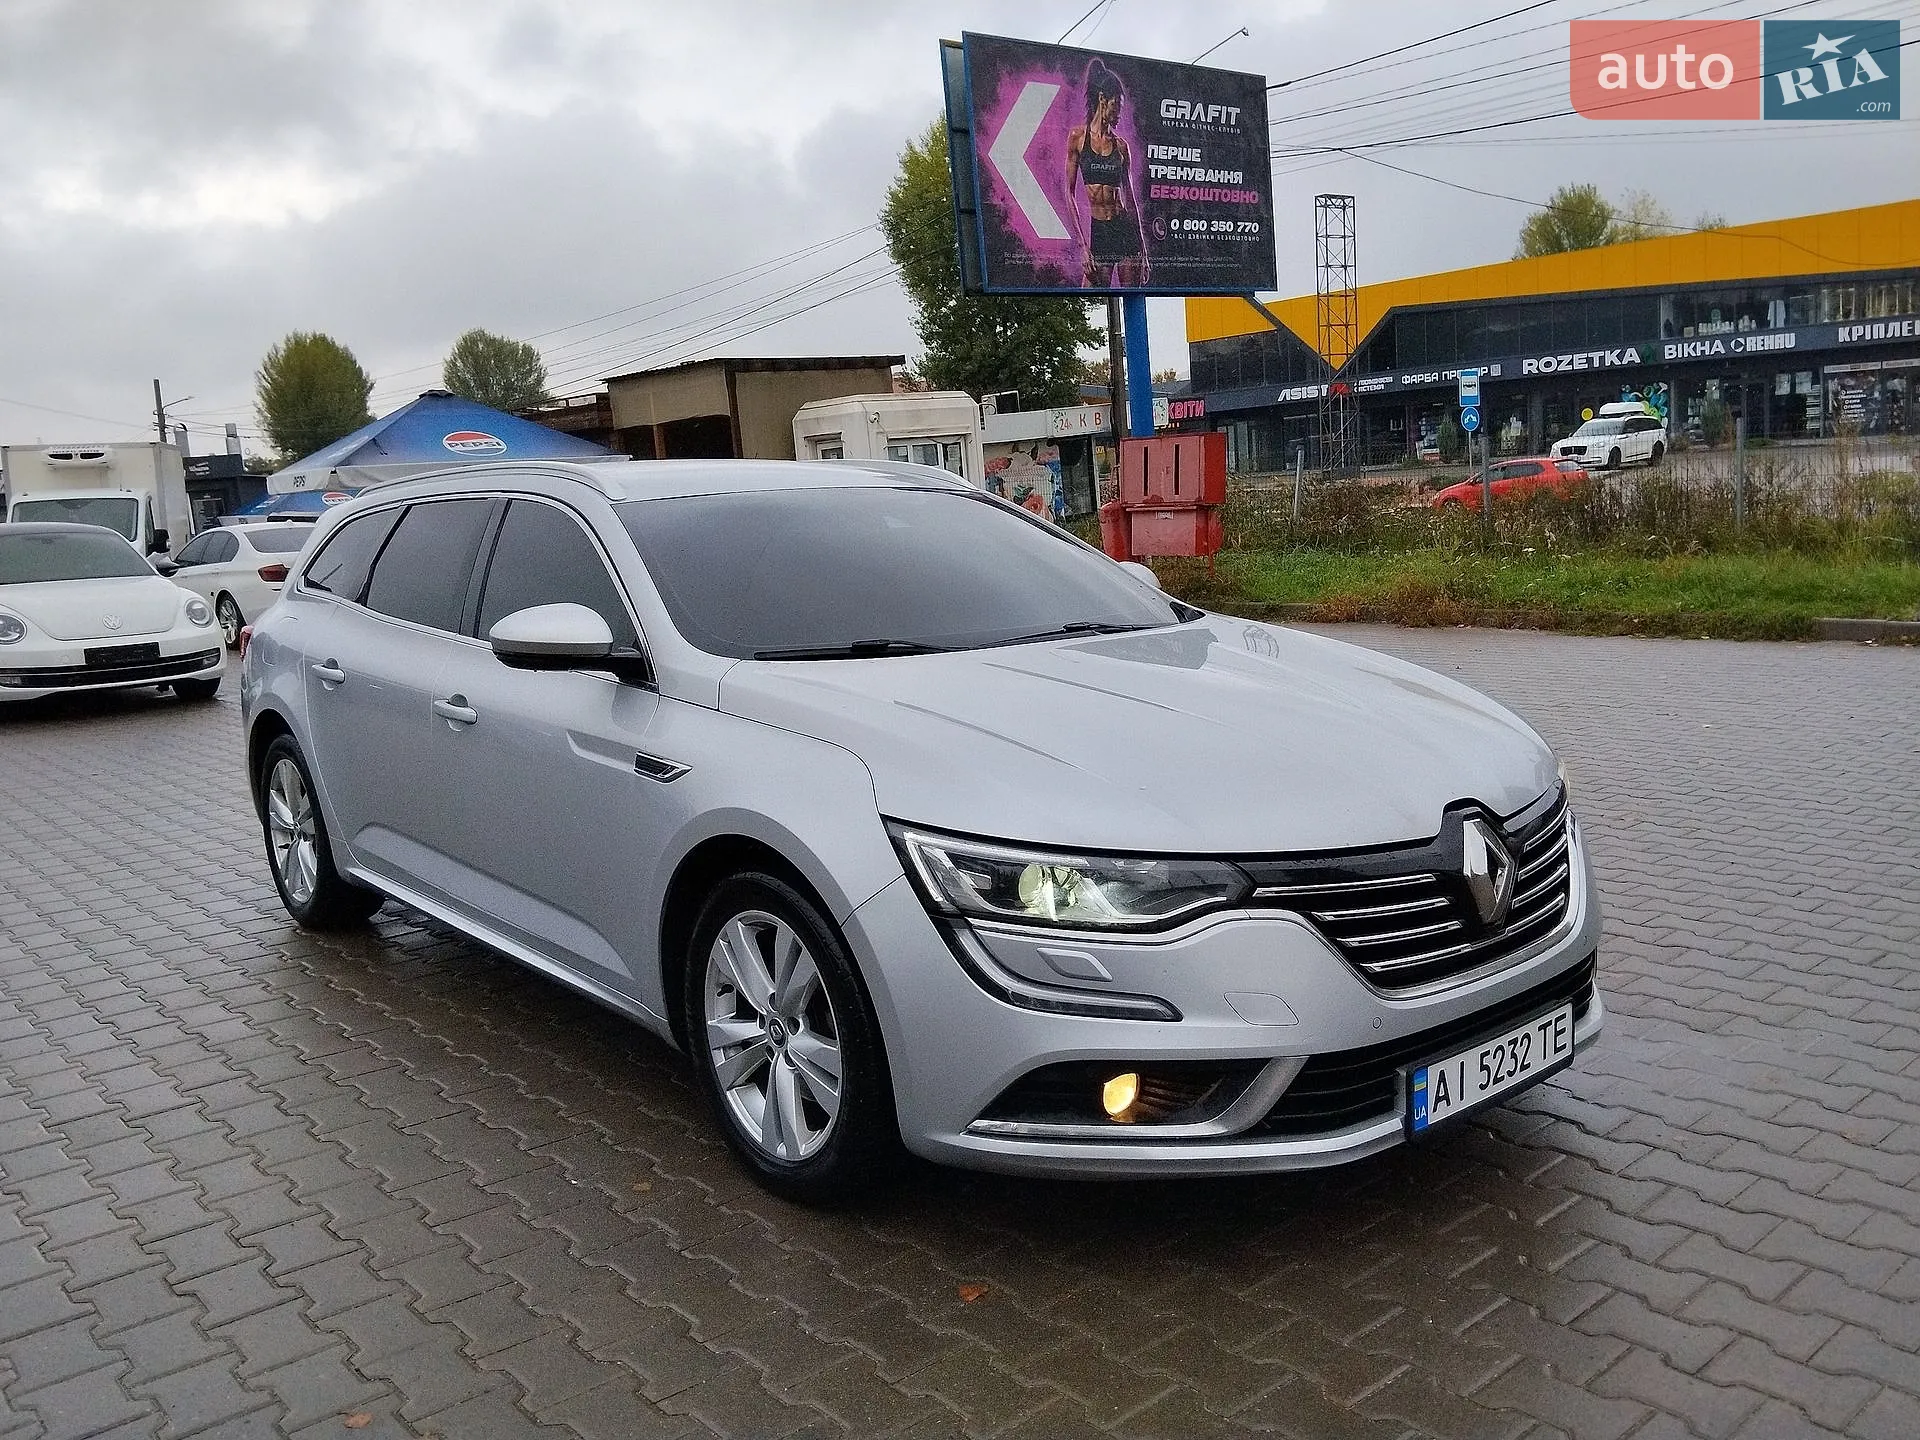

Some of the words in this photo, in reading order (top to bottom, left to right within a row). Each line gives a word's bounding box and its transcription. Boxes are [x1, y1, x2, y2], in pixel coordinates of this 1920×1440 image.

[1160, 99, 1241, 125] GRAFIT
[1147, 144, 1202, 163] ПЕРШЕ
[1148, 164, 1243, 185] ТРЕНУВАННЯ
[1150, 184, 1259, 204] БЕЗКОШТОВНО
[1170, 218, 1180, 231] 0
[1183, 219, 1208, 232] 800
[1210, 221, 1234, 233] 350
[1236, 222, 1260, 234] 770
[1664, 339, 1726, 360] ВІКНА
[1746, 333, 1796, 352] REHAU
[1522, 347, 1641, 375] ROZETKA
[1401, 372, 1439, 386] ФАРБА
[1168, 400, 1205, 419] КВІТИ
[1432, 1060, 1465, 1113] AI
[1478, 1031, 1532, 1091] 5232
[1537, 1012, 1568, 1060] TE
[1414, 1107, 1427, 1120] UA
